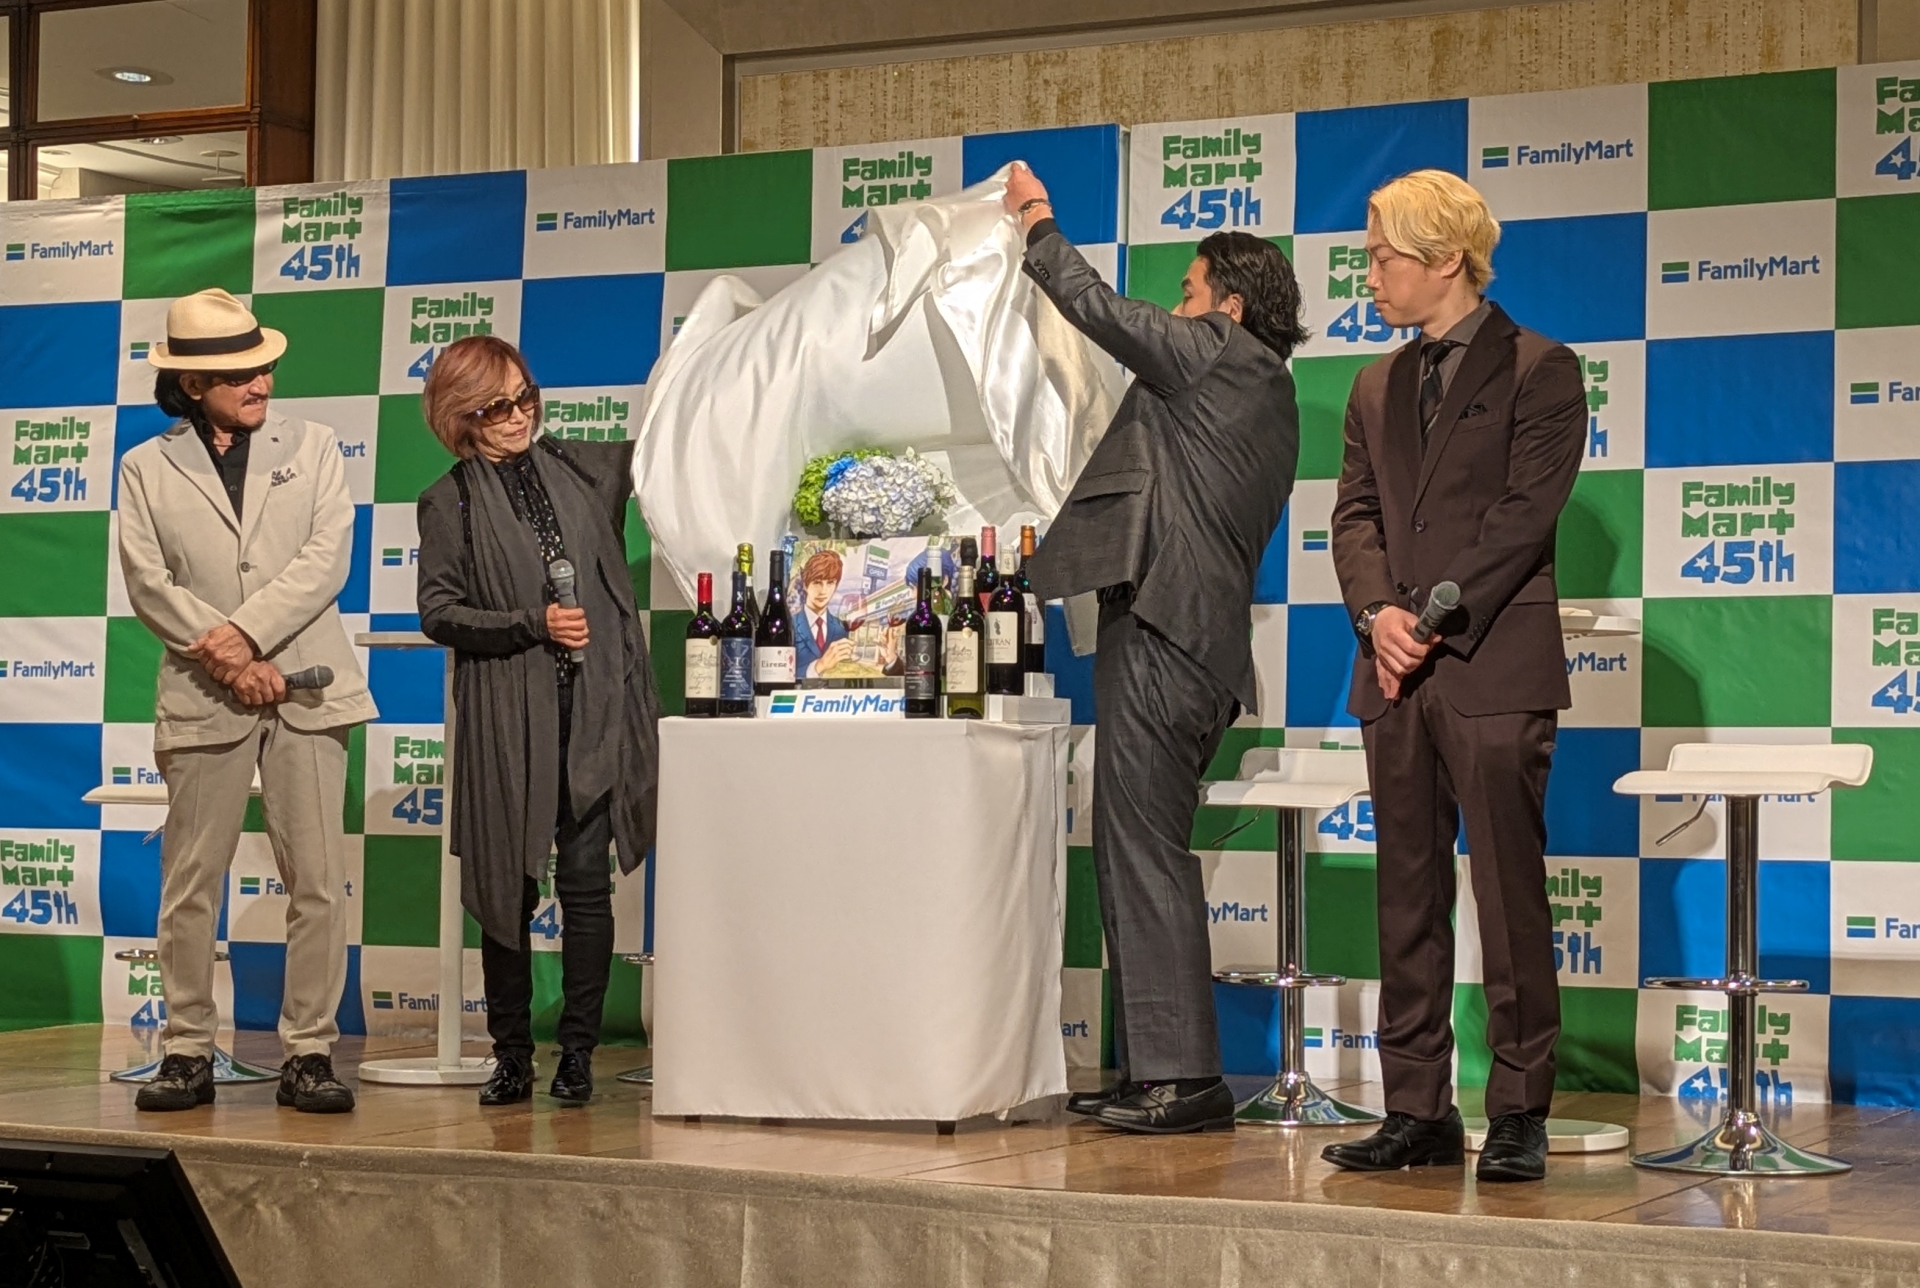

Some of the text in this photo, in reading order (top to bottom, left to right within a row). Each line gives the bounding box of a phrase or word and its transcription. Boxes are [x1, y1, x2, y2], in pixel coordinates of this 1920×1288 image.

[1163, 128, 1262, 160] Family
[1517, 138, 1634, 166] FamilyMart
[842, 151, 932, 182] Family
[1163, 157, 1262, 188] Mart
[282, 191, 363, 219] Family
[841, 179, 932, 208] Mart
[563, 208, 655, 230] FamilyMart
[1161, 187, 1261, 230] 45th
[281, 217, 362, 244] Mart
[30, 240, 114, 260] FamilyMart
[280, 244, 360, 281] 45th
[1698, 255, 1820, 281] FamilyMart
[1328, 274, 1376, 299] Ma
[411, 292, 494, 320] Family
[410, 318, 492, 345] Mart
[544, 396, 628, 422] Family
[14, 416, 91, 441] Family
[13, 441, 89, 465] Mart
[11, 467, 87, 502] 45th
[1682, 476, 1795, 508] Family
[1681, 508, 1795, 538] Mart
[1680, 539, 1795, 584] 45th
[1565, 652, 1627, 675] yMart
[1872, 638, 1920, 666] Ma
[13, 660, 95, 680] FamilyMart
[802, 694, 907, 715] FamilyMart
[394, 736, 444, 759] Fam
[392, 788, 444, 824] 45
[1318, 800, 1377, 842] 45
[0, 838, 75, 864] Family
[1, 864, 74, 888] Mart
[1545, 868, 1602, 898] mily
[1, 888, 79, 925] 45th
[1205, 902, 1268, 924] lyMart
[1550, 900, 1602, 928] rt
